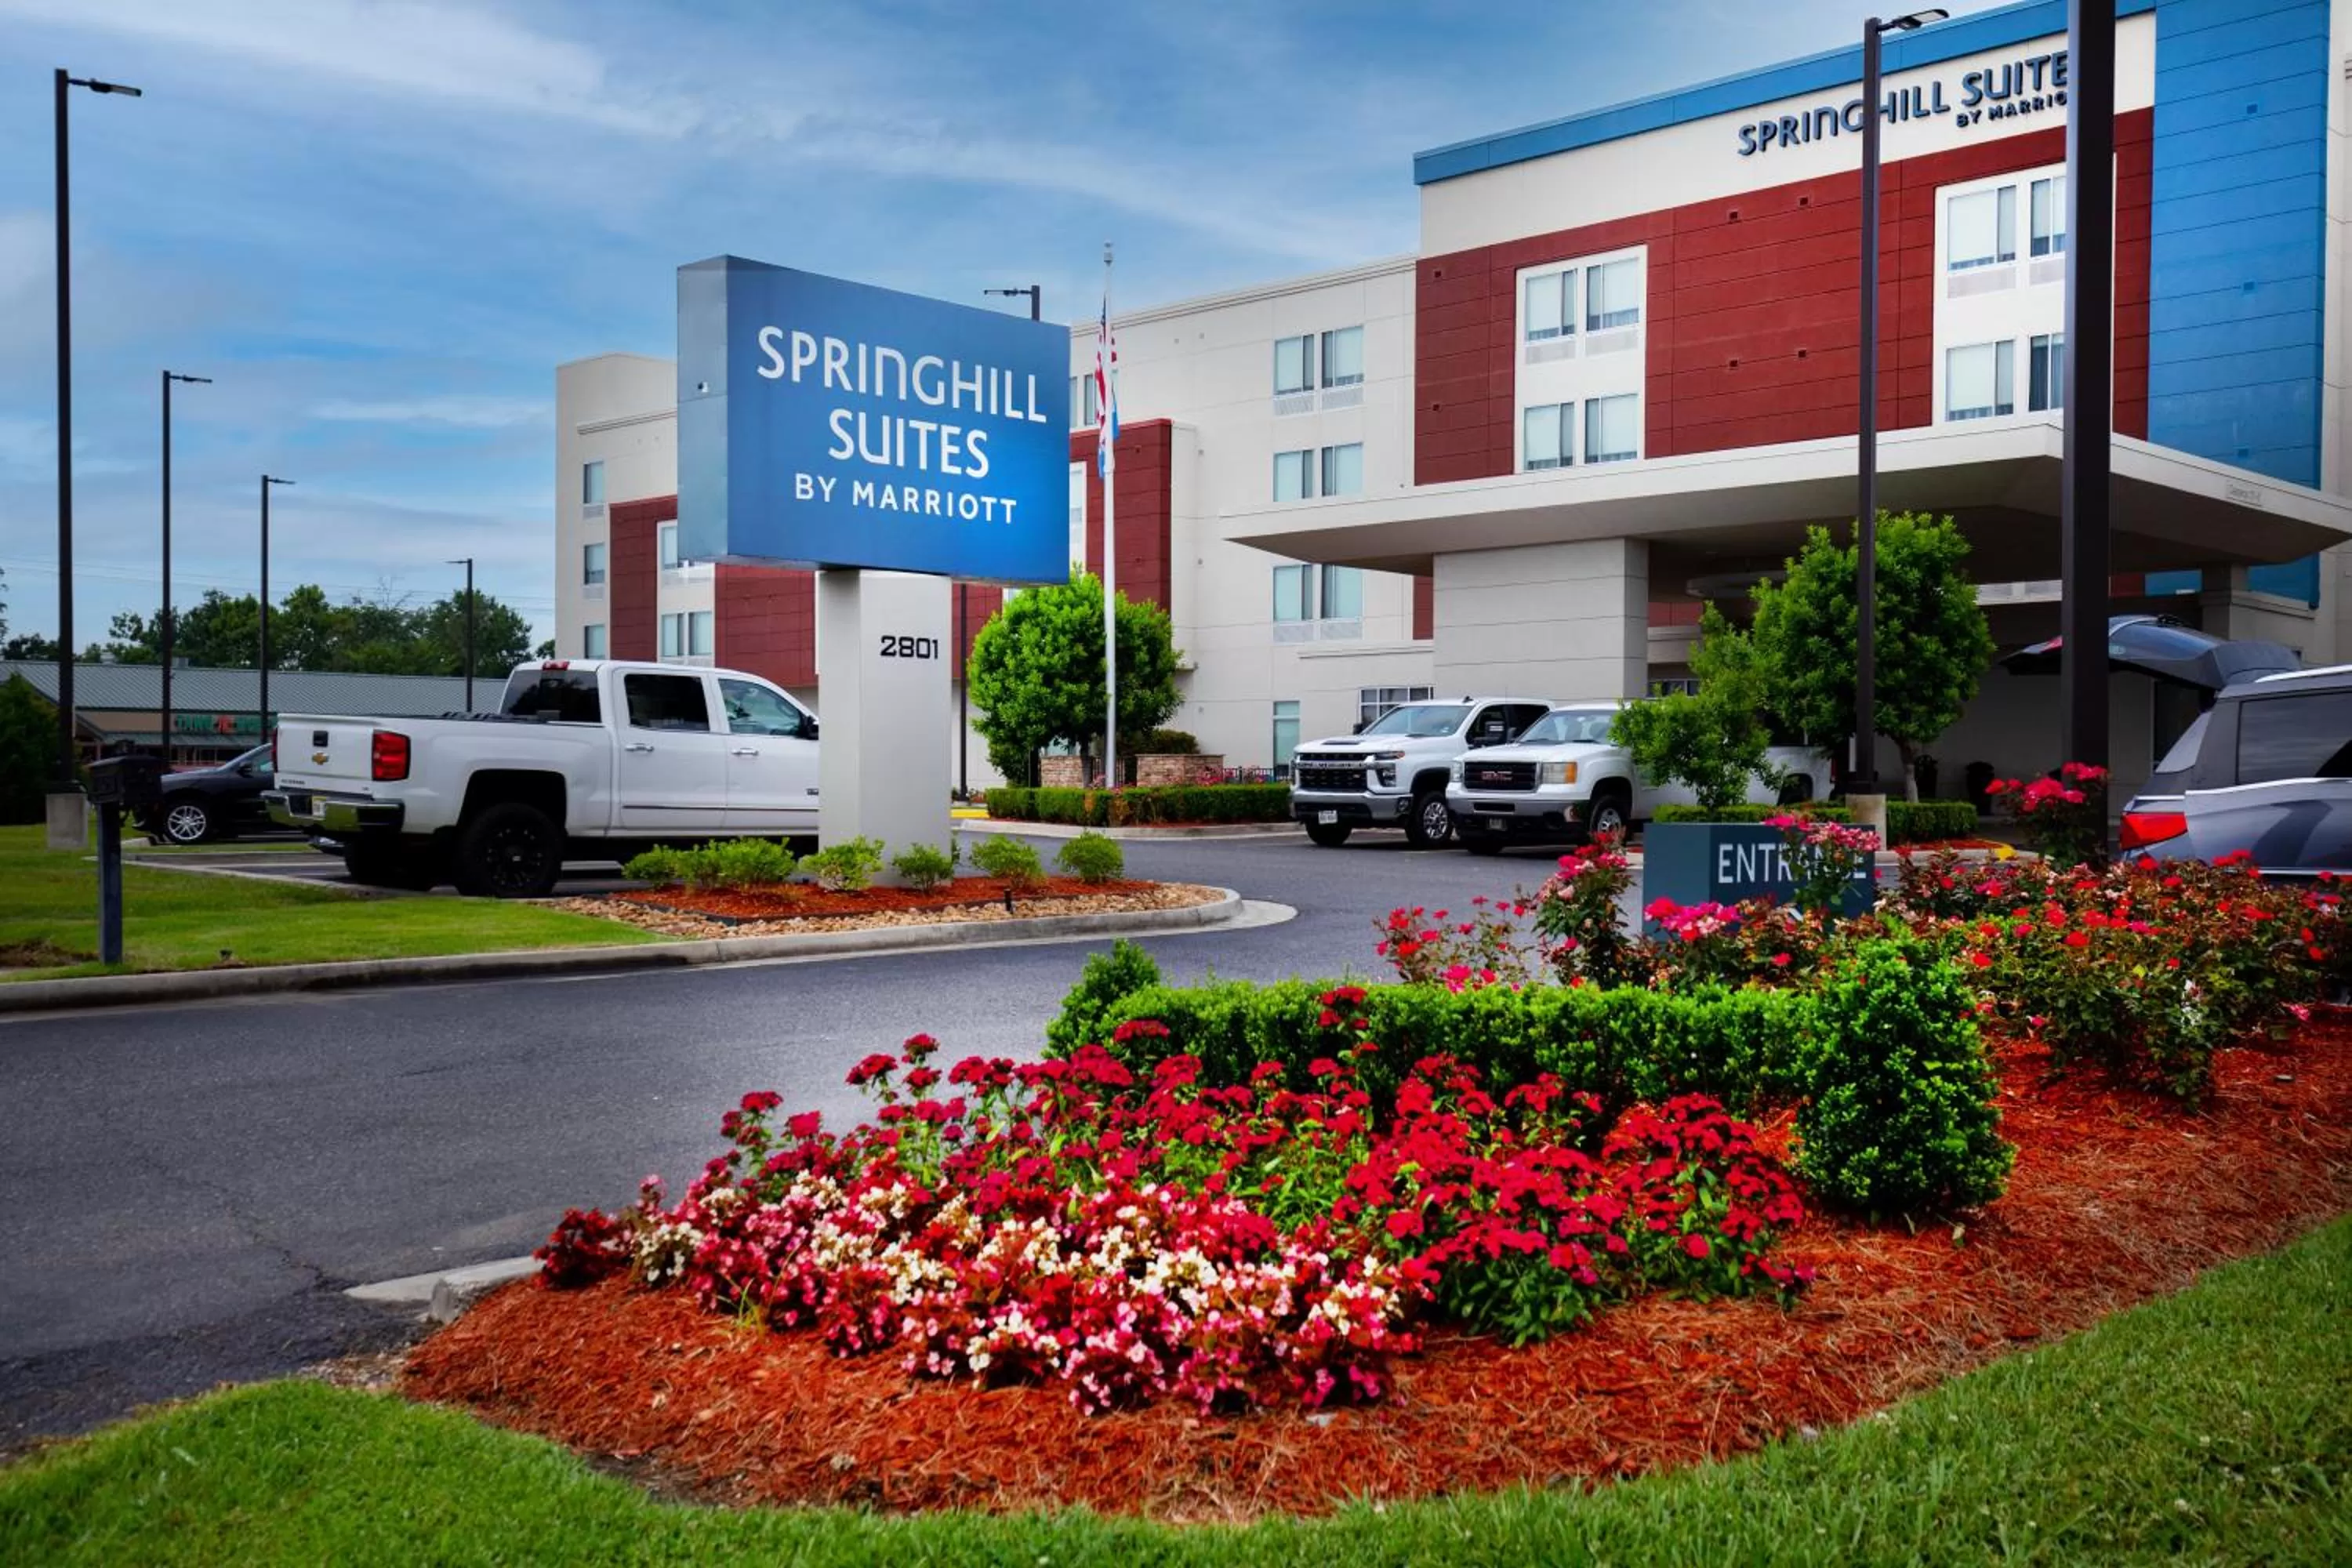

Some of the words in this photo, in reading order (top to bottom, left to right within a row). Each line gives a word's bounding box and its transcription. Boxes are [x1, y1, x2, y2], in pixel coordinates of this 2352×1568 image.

[1737, 81, 1951, 155] SPRINGHILL
[1961, 50, 2067, 106] SUITE
[1956, 110, 1981, 128] BY
[1988, 90, 2067, 122] MARRIO
[757, 325, 1047, 423] SPRINGHILL
[828, 408, 990, 480] SUITES
[795, 473, 837, 503] BY
[851, 480, 1018, 524] MARRIOTT
[880, 635, 940, 659] 2801
[1481, 771, 1513, 781] GMC
[1718, 843, 1867, 884] ENTRE
